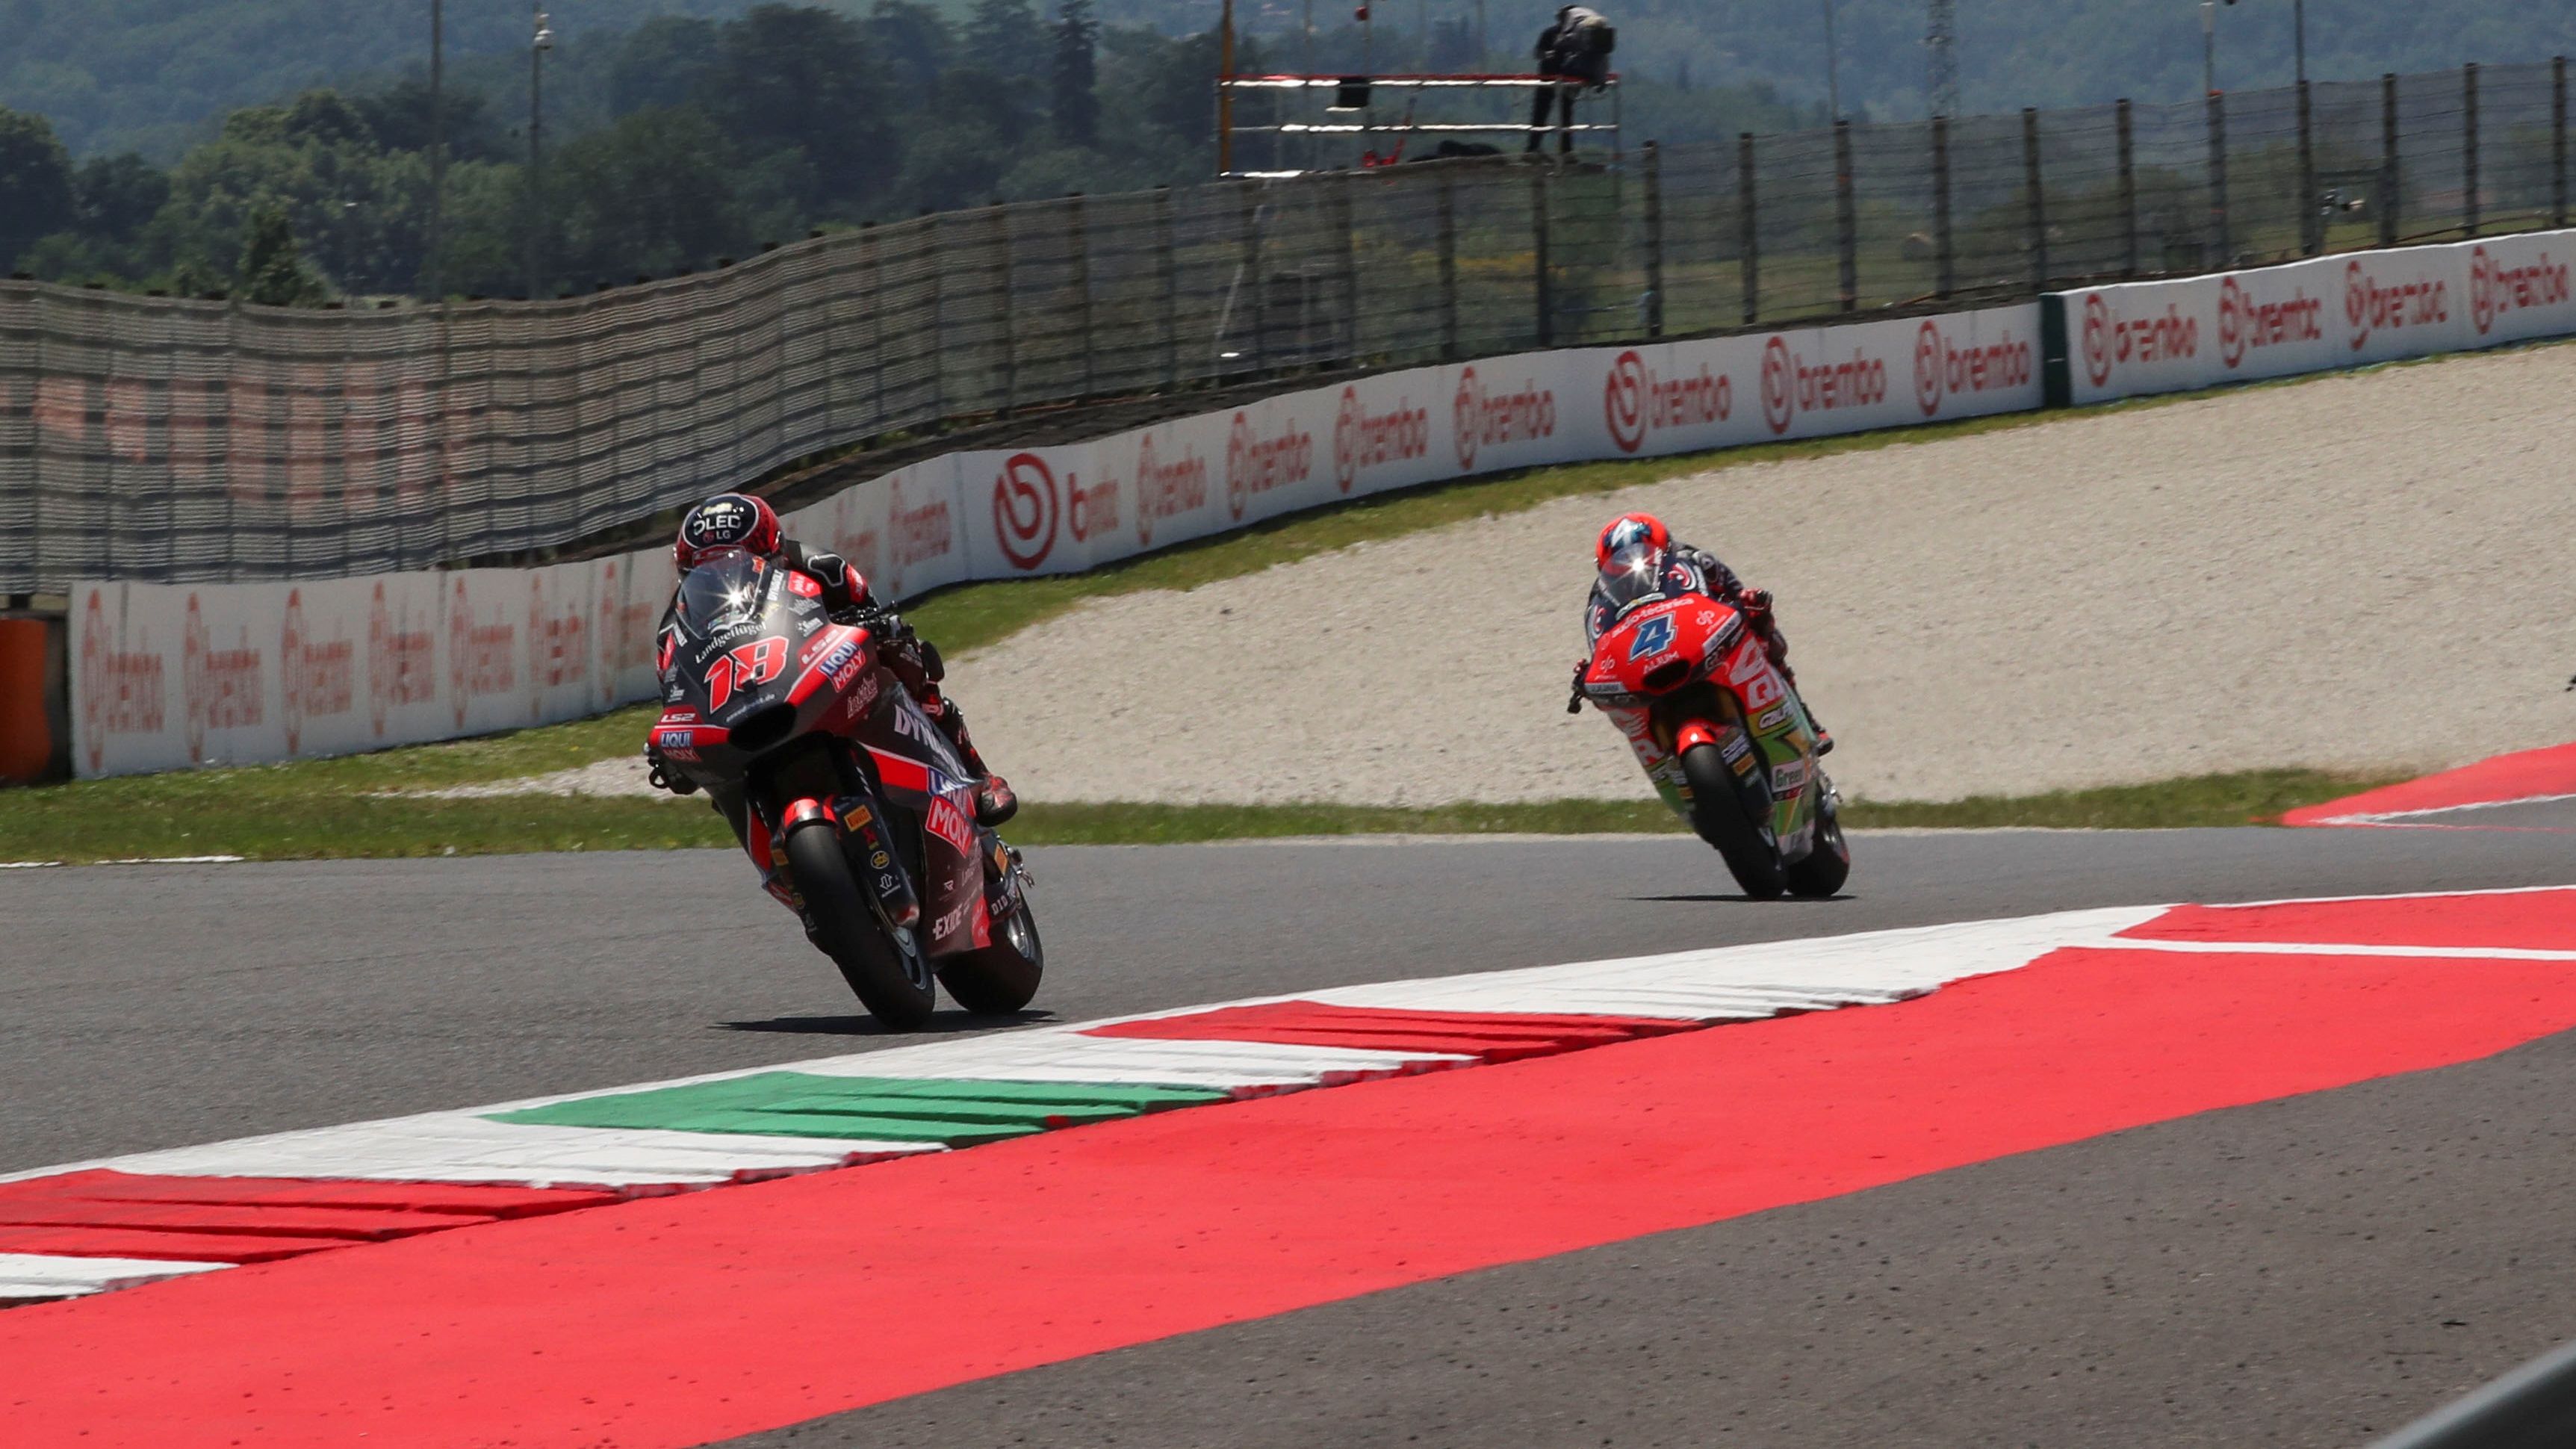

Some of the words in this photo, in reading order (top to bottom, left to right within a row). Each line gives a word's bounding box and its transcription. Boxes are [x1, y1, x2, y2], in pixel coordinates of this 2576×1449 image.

[1793, 347, 1887, 410] brembo
[1945, 330, 2031, 394] brembo
[716, 530, 731, 539] LG
[1627, 610, 1678, 664] 4
[819, 640, 858, 676] LIQUI
[833, 650, 863, 690] MOLY
[660, 713, 696, 723] LS2
[660, 730, 691, 748] LIQUI
[931, 799, 970, 851] MOLY
